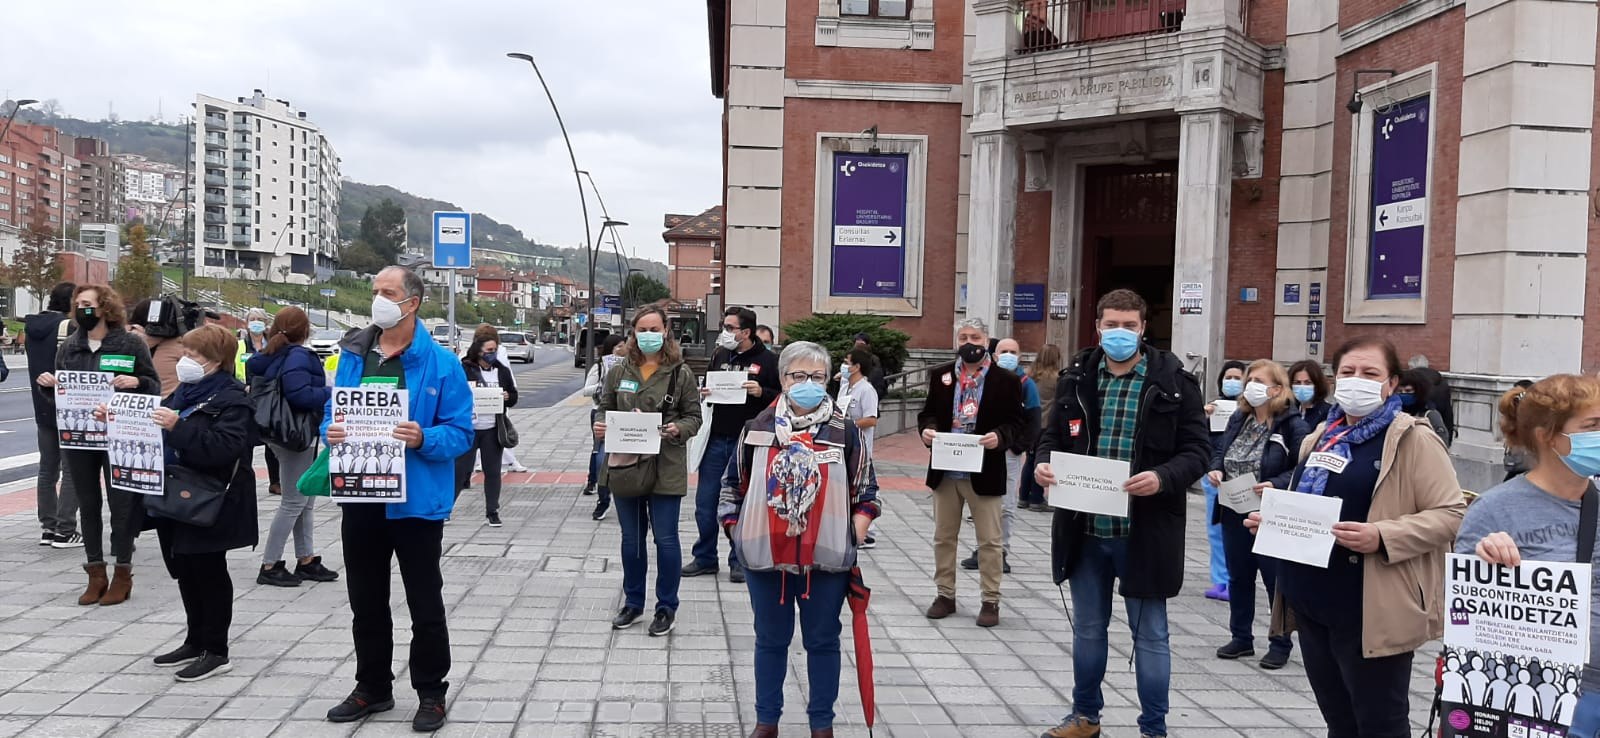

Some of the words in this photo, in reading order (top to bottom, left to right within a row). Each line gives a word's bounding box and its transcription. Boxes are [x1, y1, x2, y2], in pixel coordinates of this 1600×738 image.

[1195, 69, 1210, 84] 16
[1014, 87, 1066, 103] PABELLON
[1071, 82, 1114, 98] ARRUPE
[838, 227, 870, 235] Consultas
[838, 235, 866, 243] Externas
[57, 371, 109, 385] GREBA
[111, 394, 155, 411] GREBA
[336, 391, 401, 408] GREBA
[108, 408, 153, 419] OSAKIDETZA
[335, 407, 403, 417] OSAKIDETZAN
[1516, 524, 1554, 545] VISIT
[1452, 557, 1578, 595] HUELGA
[1452, 584, 1555, 607] SUBCONTRATAS
[1559, 597, 1579, 610] DE
[1452, 597, 1578, 629] OSAKIDETZA
[1452, 611, 1467, 621] SOS
[1487, 627, 1513, 637] SUKALDE
[1512, 726, 1523, 735] 29
